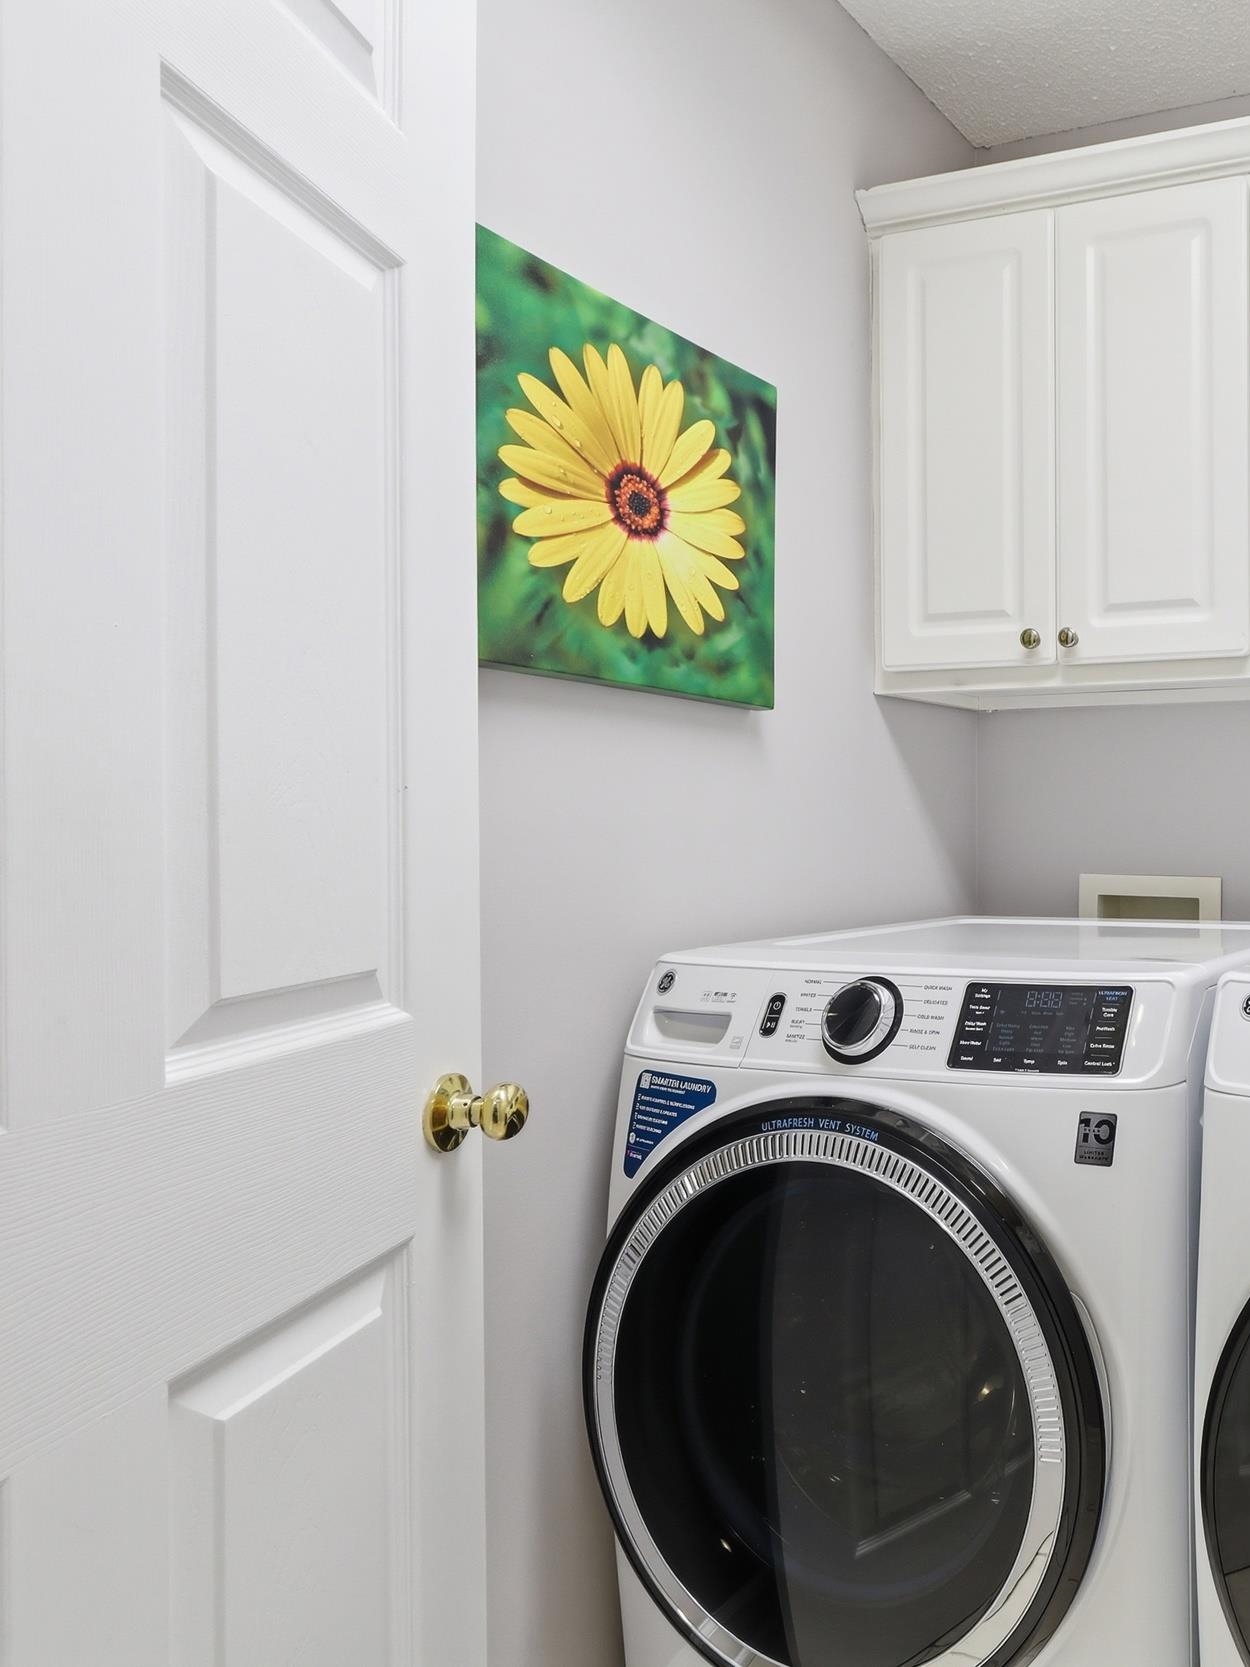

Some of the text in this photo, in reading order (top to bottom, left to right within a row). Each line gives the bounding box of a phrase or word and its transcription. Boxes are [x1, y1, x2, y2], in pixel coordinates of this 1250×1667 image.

[651, 1075, 680, 1089] SMARTER
[680, 1081, 712, 1094] LAUNDRY
[761, 1117, 879, 1141] ULTRAFRESH VENT SYSTEM
[1079, 1118, 1115, 1144] 10
